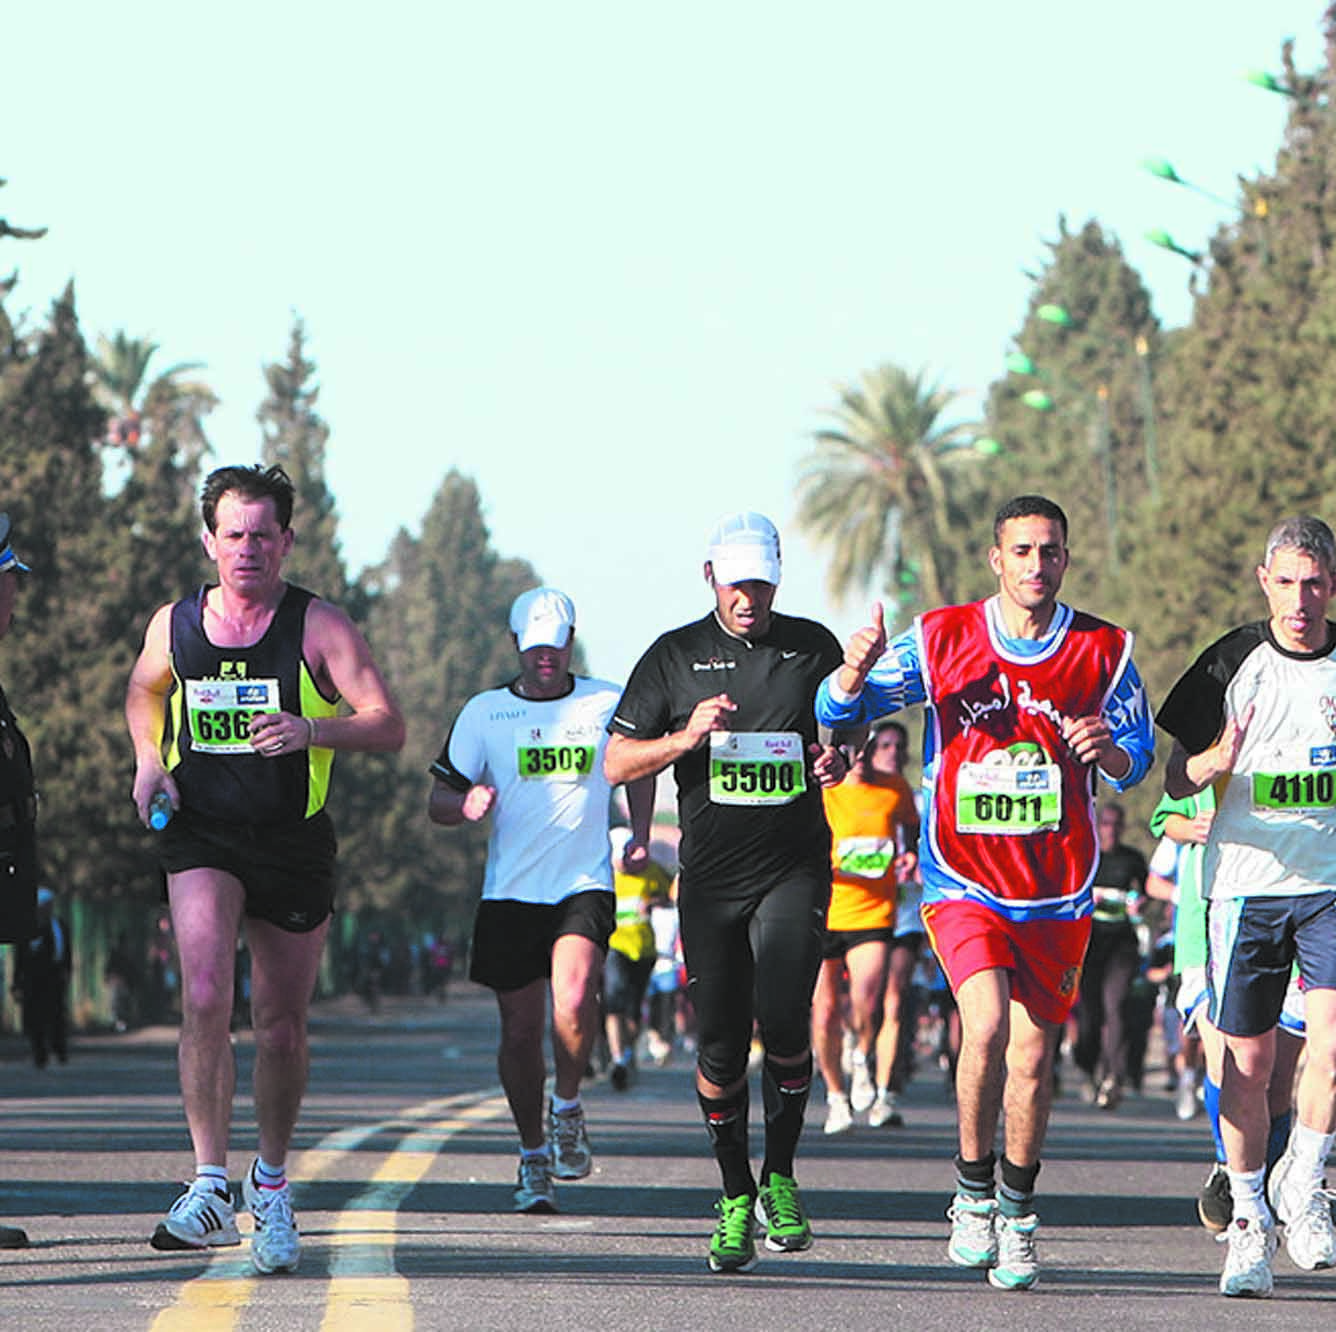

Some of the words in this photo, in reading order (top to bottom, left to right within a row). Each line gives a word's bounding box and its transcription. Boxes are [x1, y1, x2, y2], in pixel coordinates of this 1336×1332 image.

[197, 709, 267, 740] 636
[526, 746, 587, 774] 3503
[720, 762, 794, 793] 5500
[1269, 771, 1334, 804] 4110
[974, 793, 1042, 822] 6011
